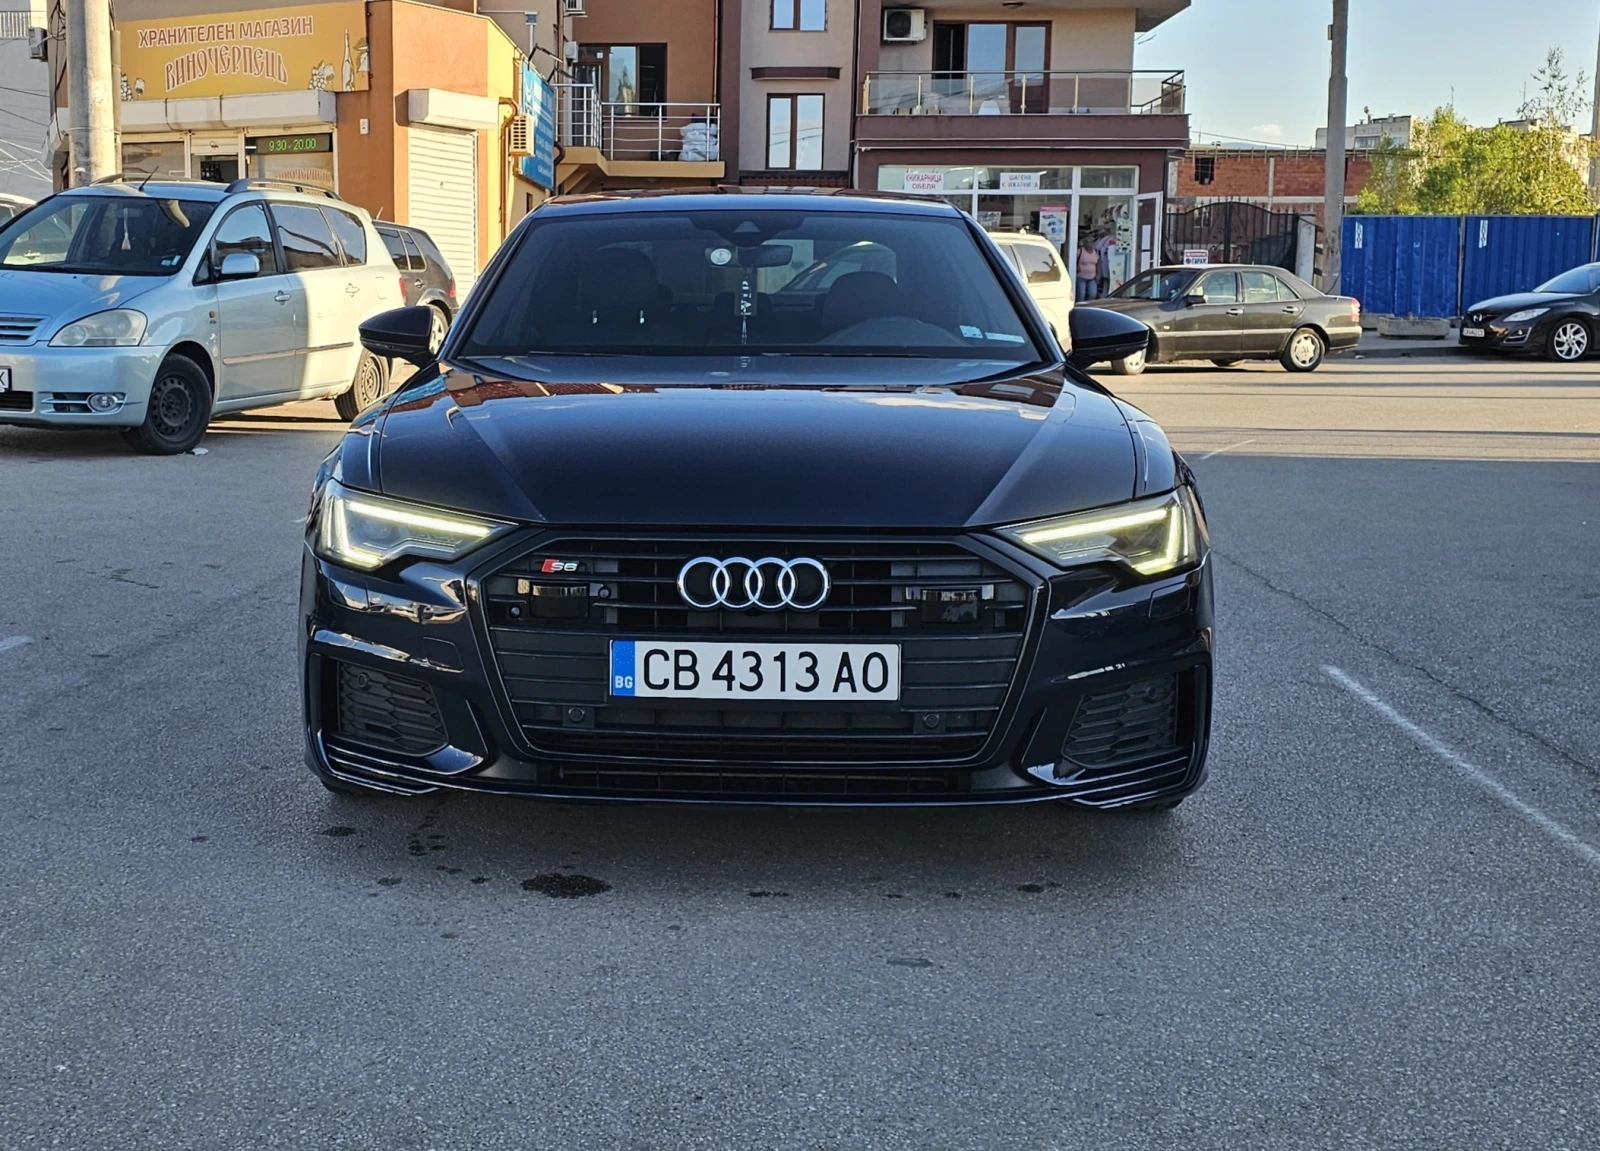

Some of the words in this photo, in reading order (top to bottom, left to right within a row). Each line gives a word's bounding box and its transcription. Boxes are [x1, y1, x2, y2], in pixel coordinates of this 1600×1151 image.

[138, 23, 237, 48] ХРАНИТЕЛЕН
[239, 15, 314, 39] МАГАЗИН
[293, 138, 317, 150] 20.00
[905, 173, 943, 183] КНИЖАРНИЦА
[550, 562, 578, 572] S6
[642, 649, 700, 691] CB
[711, 650, 820, 693] 4313
[614, 675, 634, 690] BG
